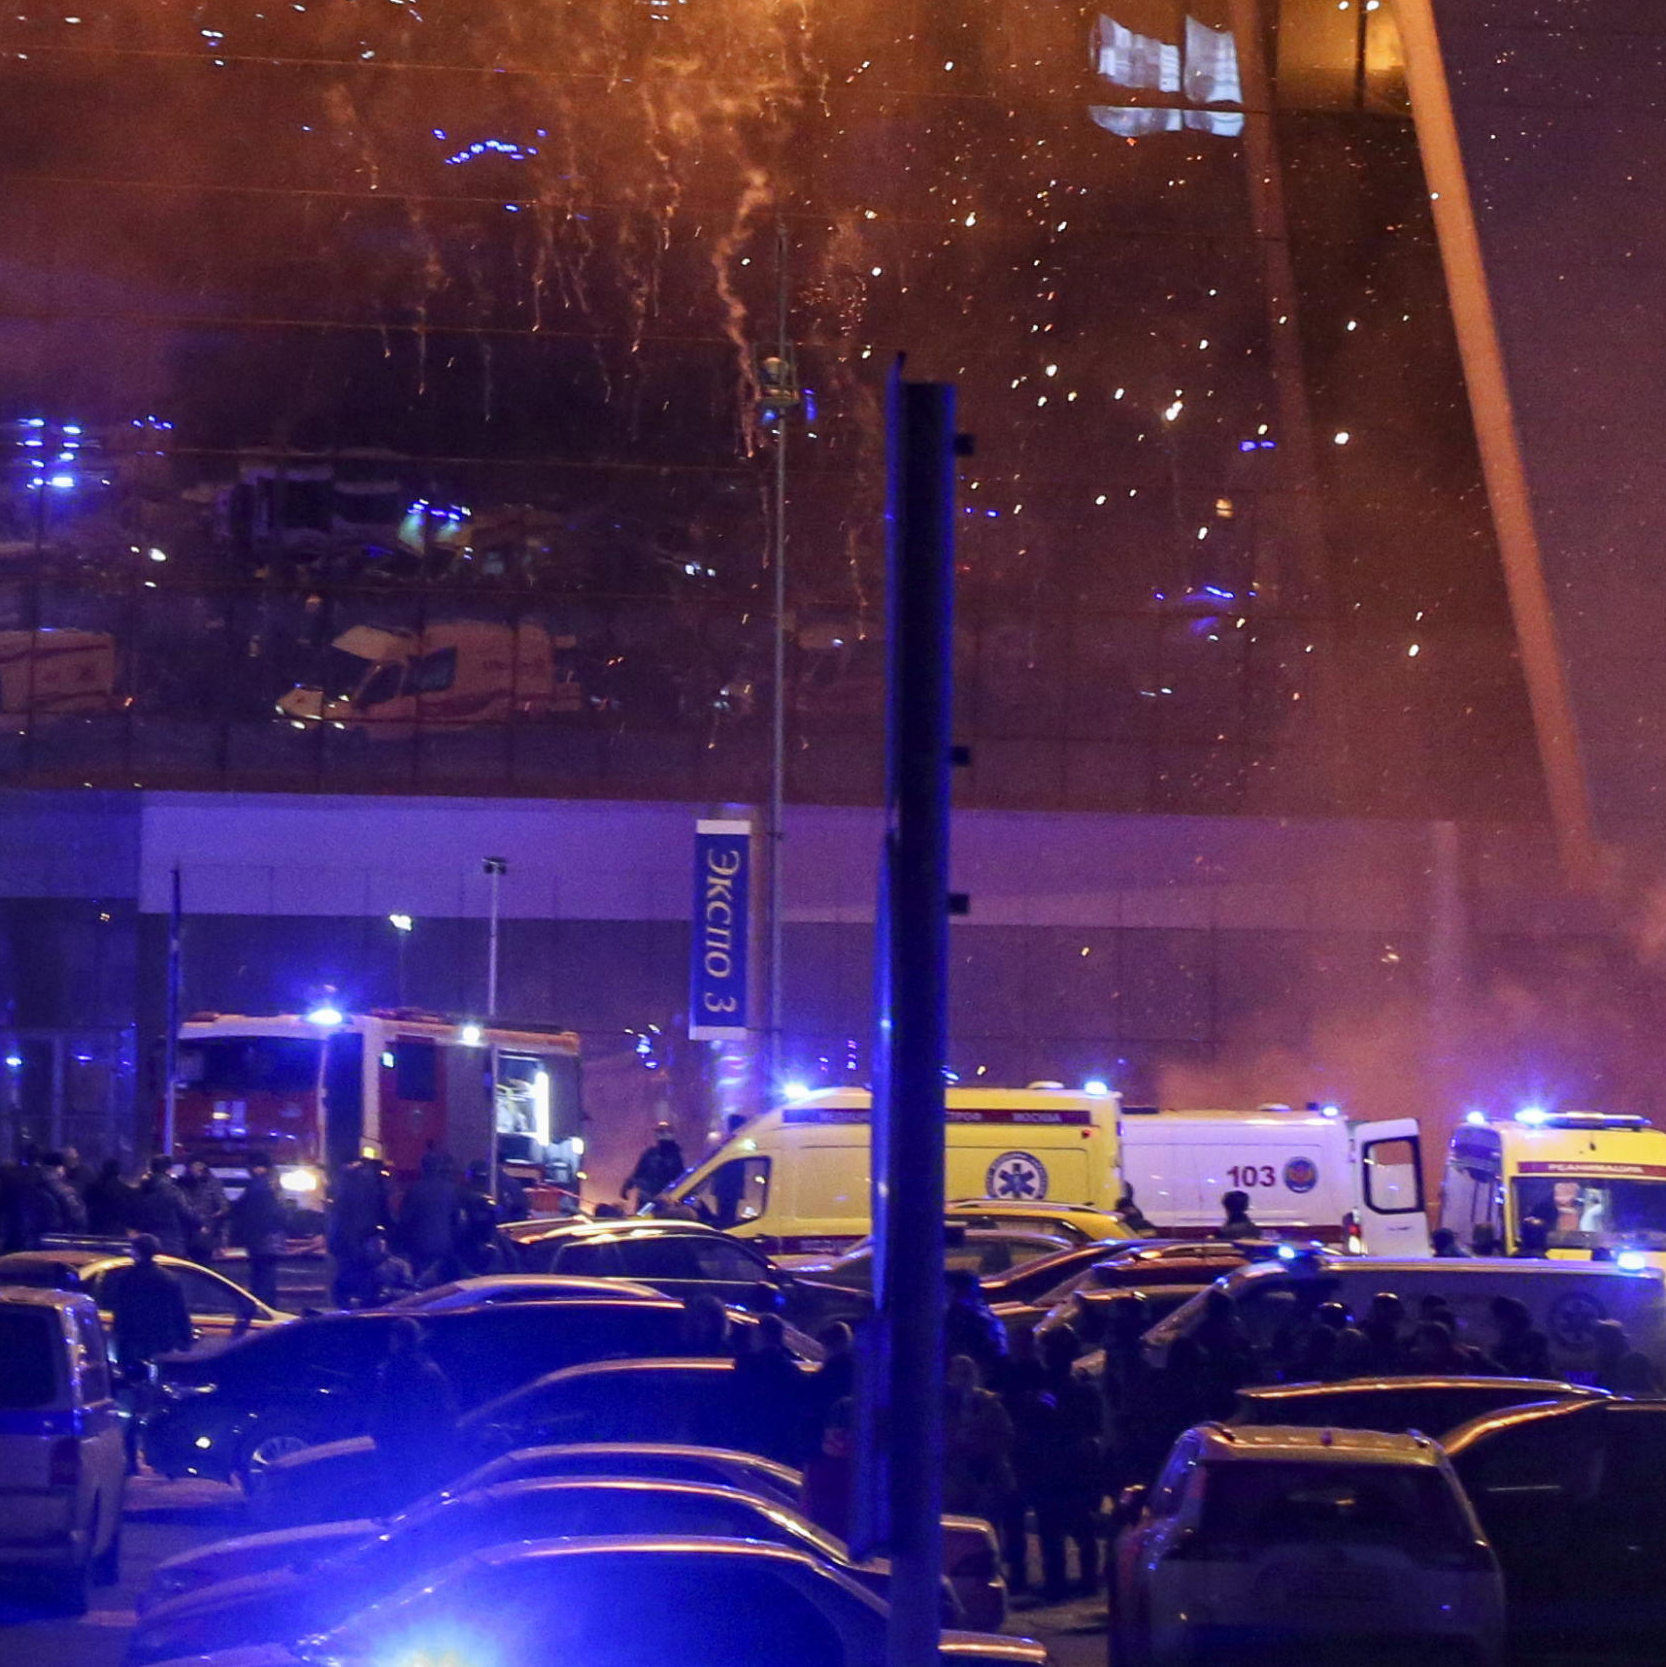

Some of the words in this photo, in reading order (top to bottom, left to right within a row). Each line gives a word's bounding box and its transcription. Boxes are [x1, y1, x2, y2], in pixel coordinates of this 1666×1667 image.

[704, 847, 741, 979] ЭКСПО
[702, 991, 738, 1013] 3
[1226, 1165, 1276, 1188] 103
